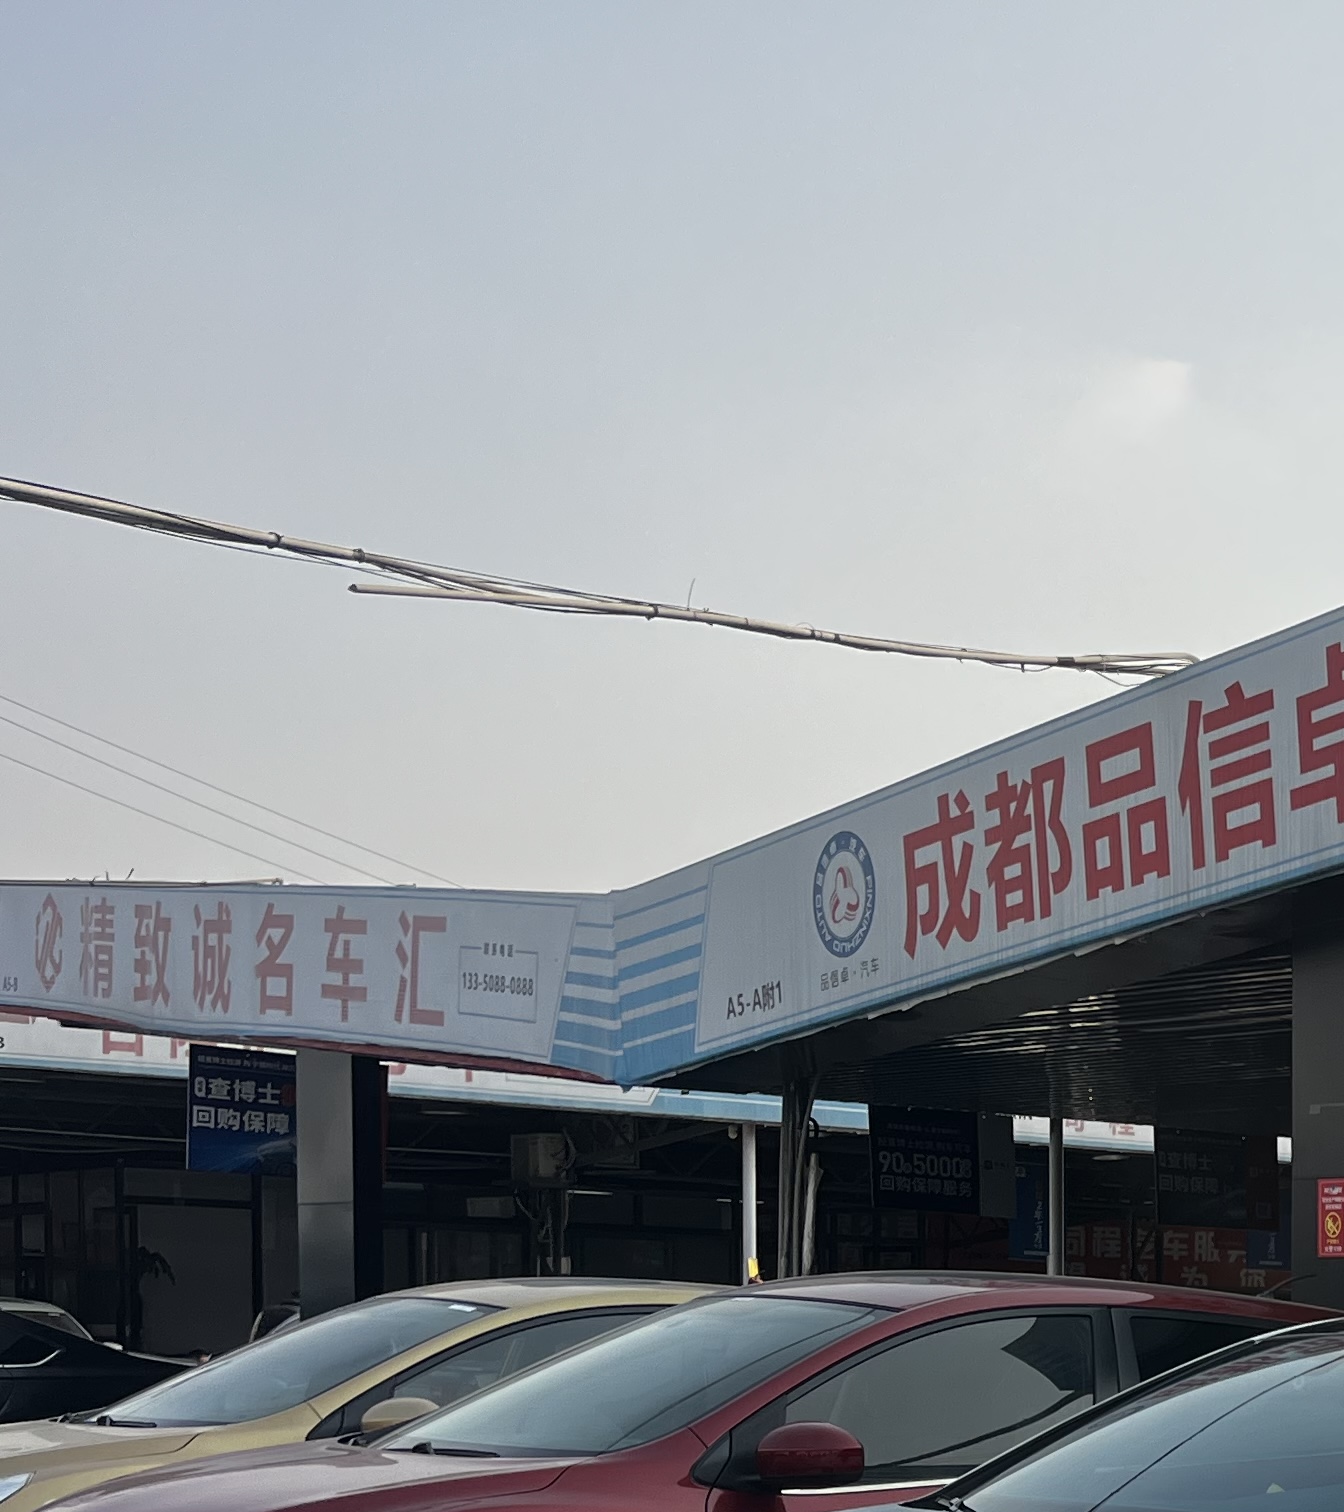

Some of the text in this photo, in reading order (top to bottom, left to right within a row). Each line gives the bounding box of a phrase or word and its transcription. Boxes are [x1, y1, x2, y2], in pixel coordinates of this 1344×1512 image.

[80, 896, 447, 1027] 精致诚名车汇
[192, 1105, 290, 1135] 回购保障
